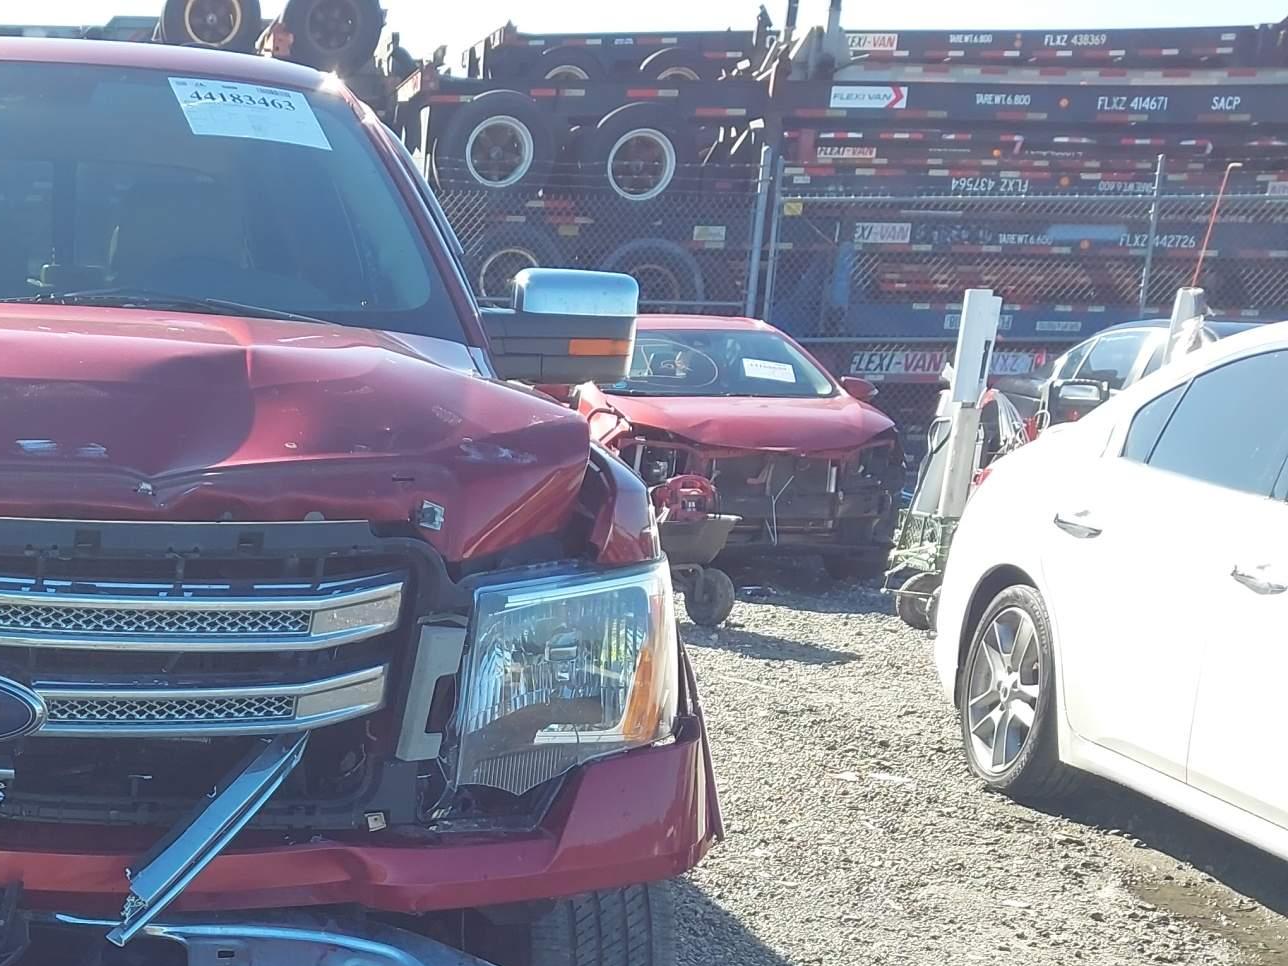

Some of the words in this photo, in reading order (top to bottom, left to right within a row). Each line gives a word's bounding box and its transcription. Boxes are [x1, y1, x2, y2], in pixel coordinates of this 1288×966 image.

[847, 35, 896, 48] EXI-VAN
[1044, 34, 1067, 46] FLXZ
[1071, 34, 1107, 45] 438369
[190, 90, 296, 111] 44183463
[1097, 97, 1126, 110] FLXZ
[1130, 96, 1168, 110] 414671
[1211, 97, 1241, 110] SACP
[951, 177, 996, 191] 437564
[999, 178, 1029, 191] FLXZ
[1120, 234, 1148, 246] FLXZ
[850, 353, 944, 374] FLEXI-VAN
